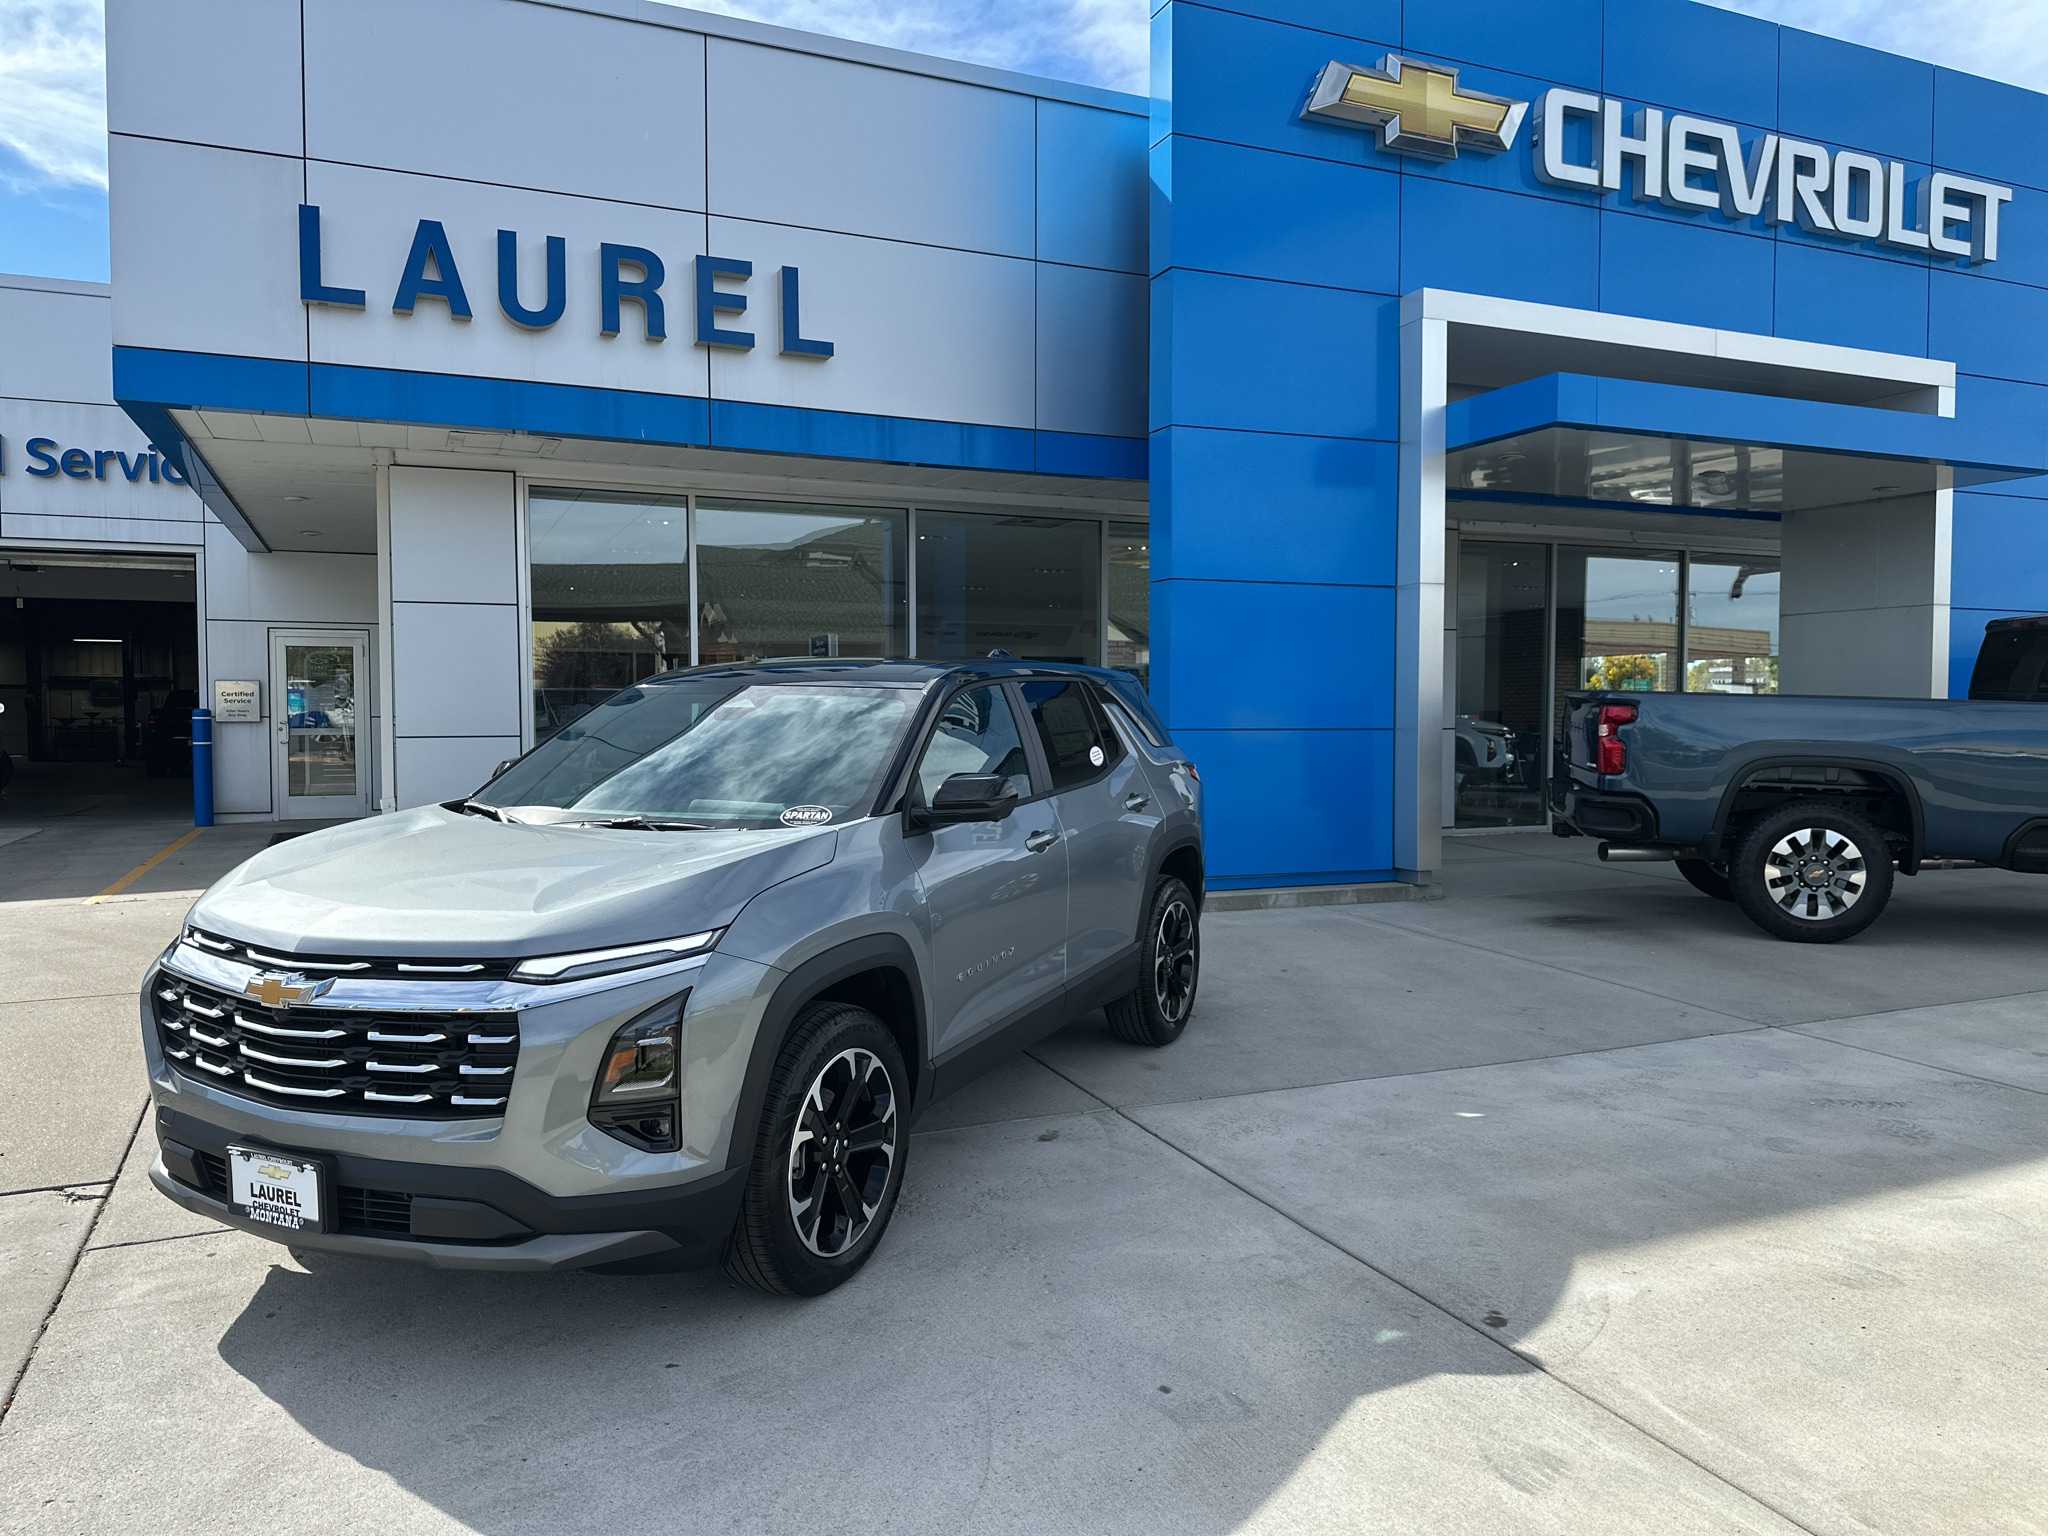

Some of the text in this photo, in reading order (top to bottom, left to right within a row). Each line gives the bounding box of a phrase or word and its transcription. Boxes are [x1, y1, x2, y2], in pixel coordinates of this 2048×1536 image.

[1534, 87, 2012, 265] CHEVROLET
[298, 203, 835, 361] LAUREL
[25, 437, 188, 484] Servic
[250, 1182, 301, 1208] LAUREL
[252, 1200, 300, 1217] CHEVROLET
[249, 1207, 300, 1229] MONTANA
